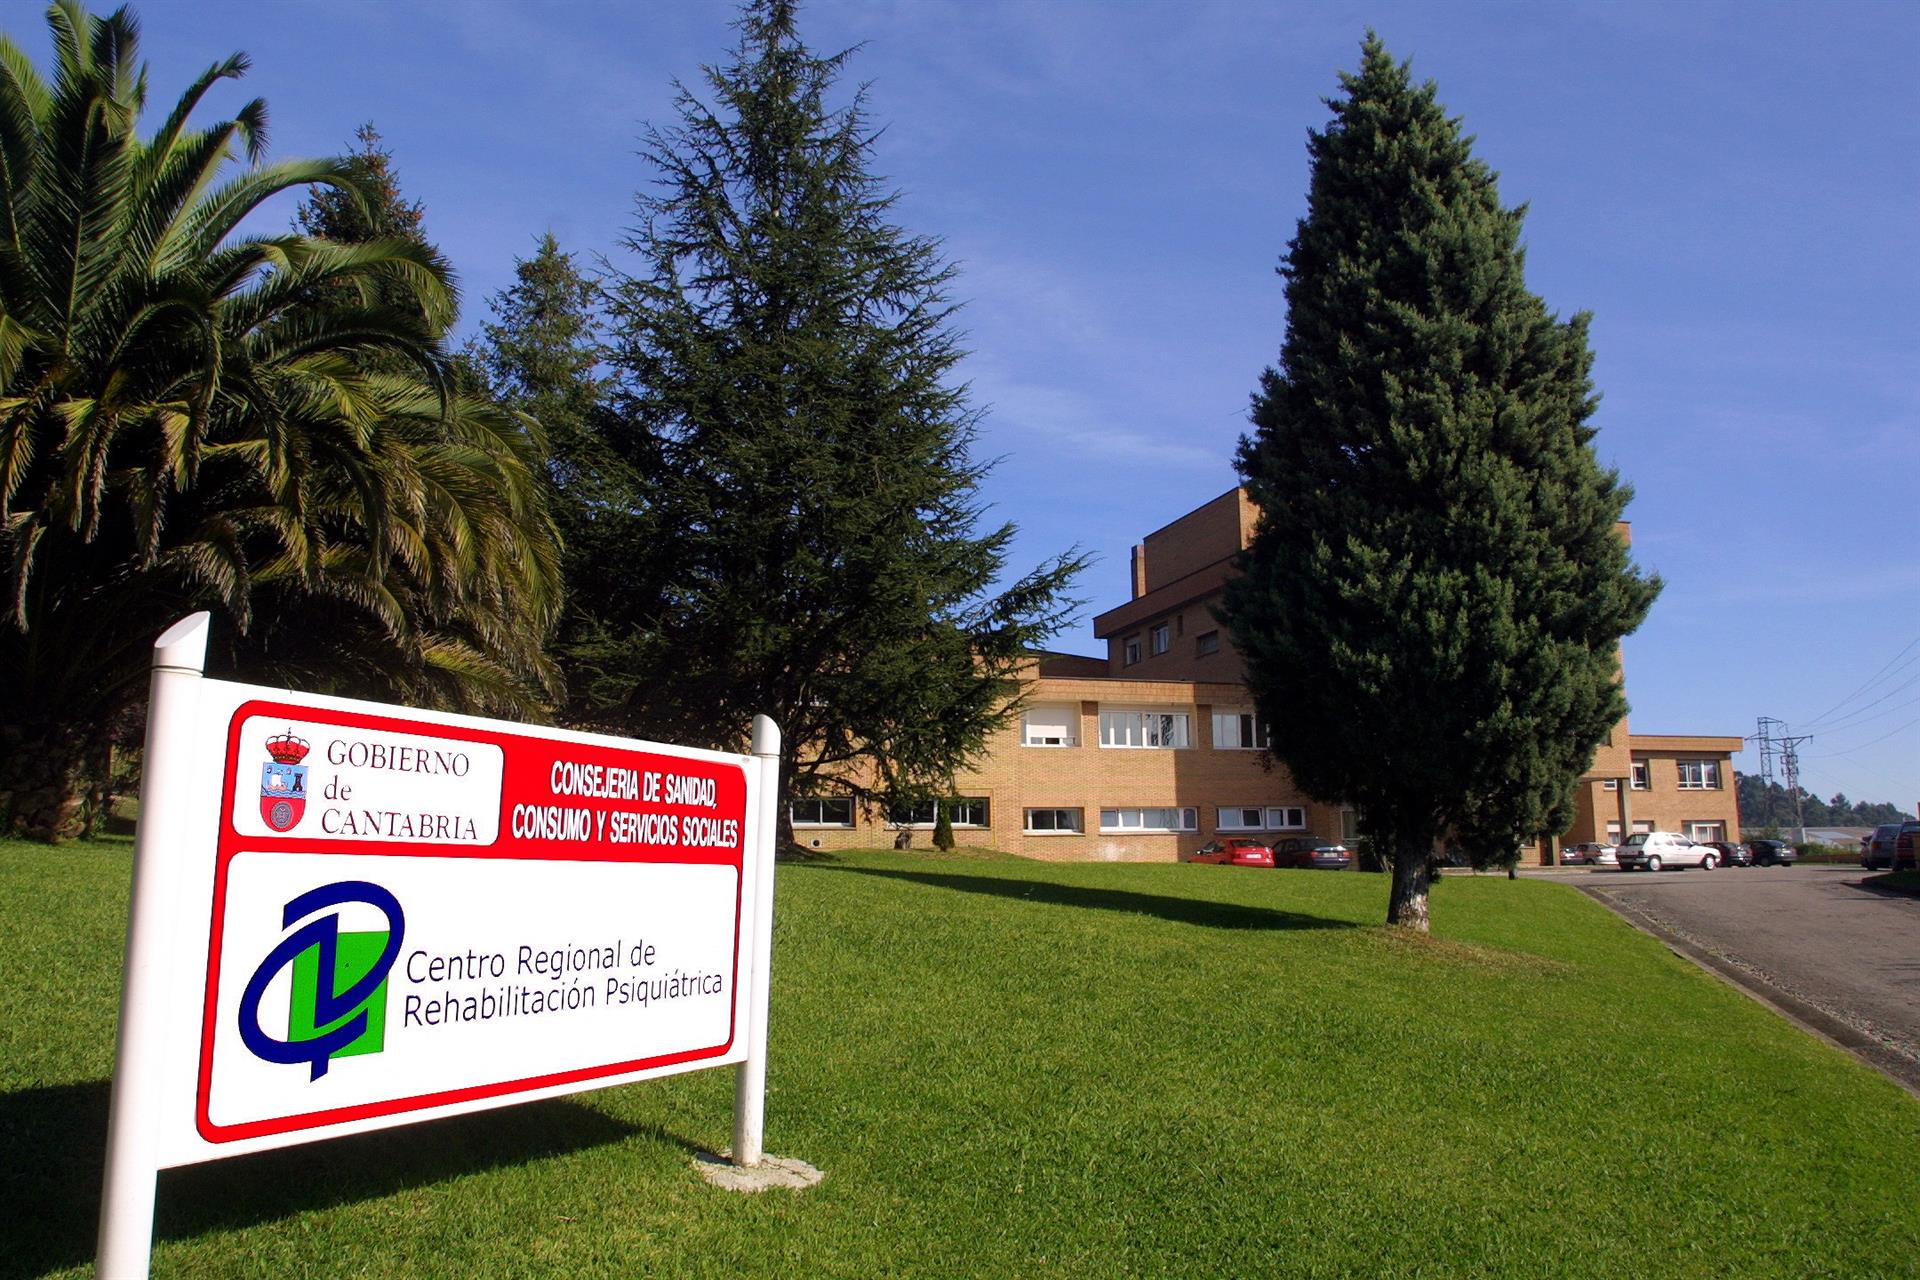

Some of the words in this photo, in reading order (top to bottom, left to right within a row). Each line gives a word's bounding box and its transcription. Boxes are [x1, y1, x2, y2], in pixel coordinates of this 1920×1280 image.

[327, 739, 470, 777] GOBIERNO
[324, 775, 352, 801] de
[551, 760, 639, 800] CONSEJERIA
[643, 771, 661, 803] DE
[665, 774, 718, 809] SANIDAD,
[322, 808, 479, 841] CANTABRIA
[512, 803, 592, 842] CONSUMO
[596, 810, 606, 842] Y
[609, 811, 679, 846] SERVICIOS
[682, 816, 738, 848] SOCIALES
[406, 949, 505, 984] Centro
[517, 940, 621, 980] Regional
[630, 939, 656, 967] de
[404, 978, 596, 1028] Rehabilitación
[606, 969, 723, 1008] Psiquiátrica
